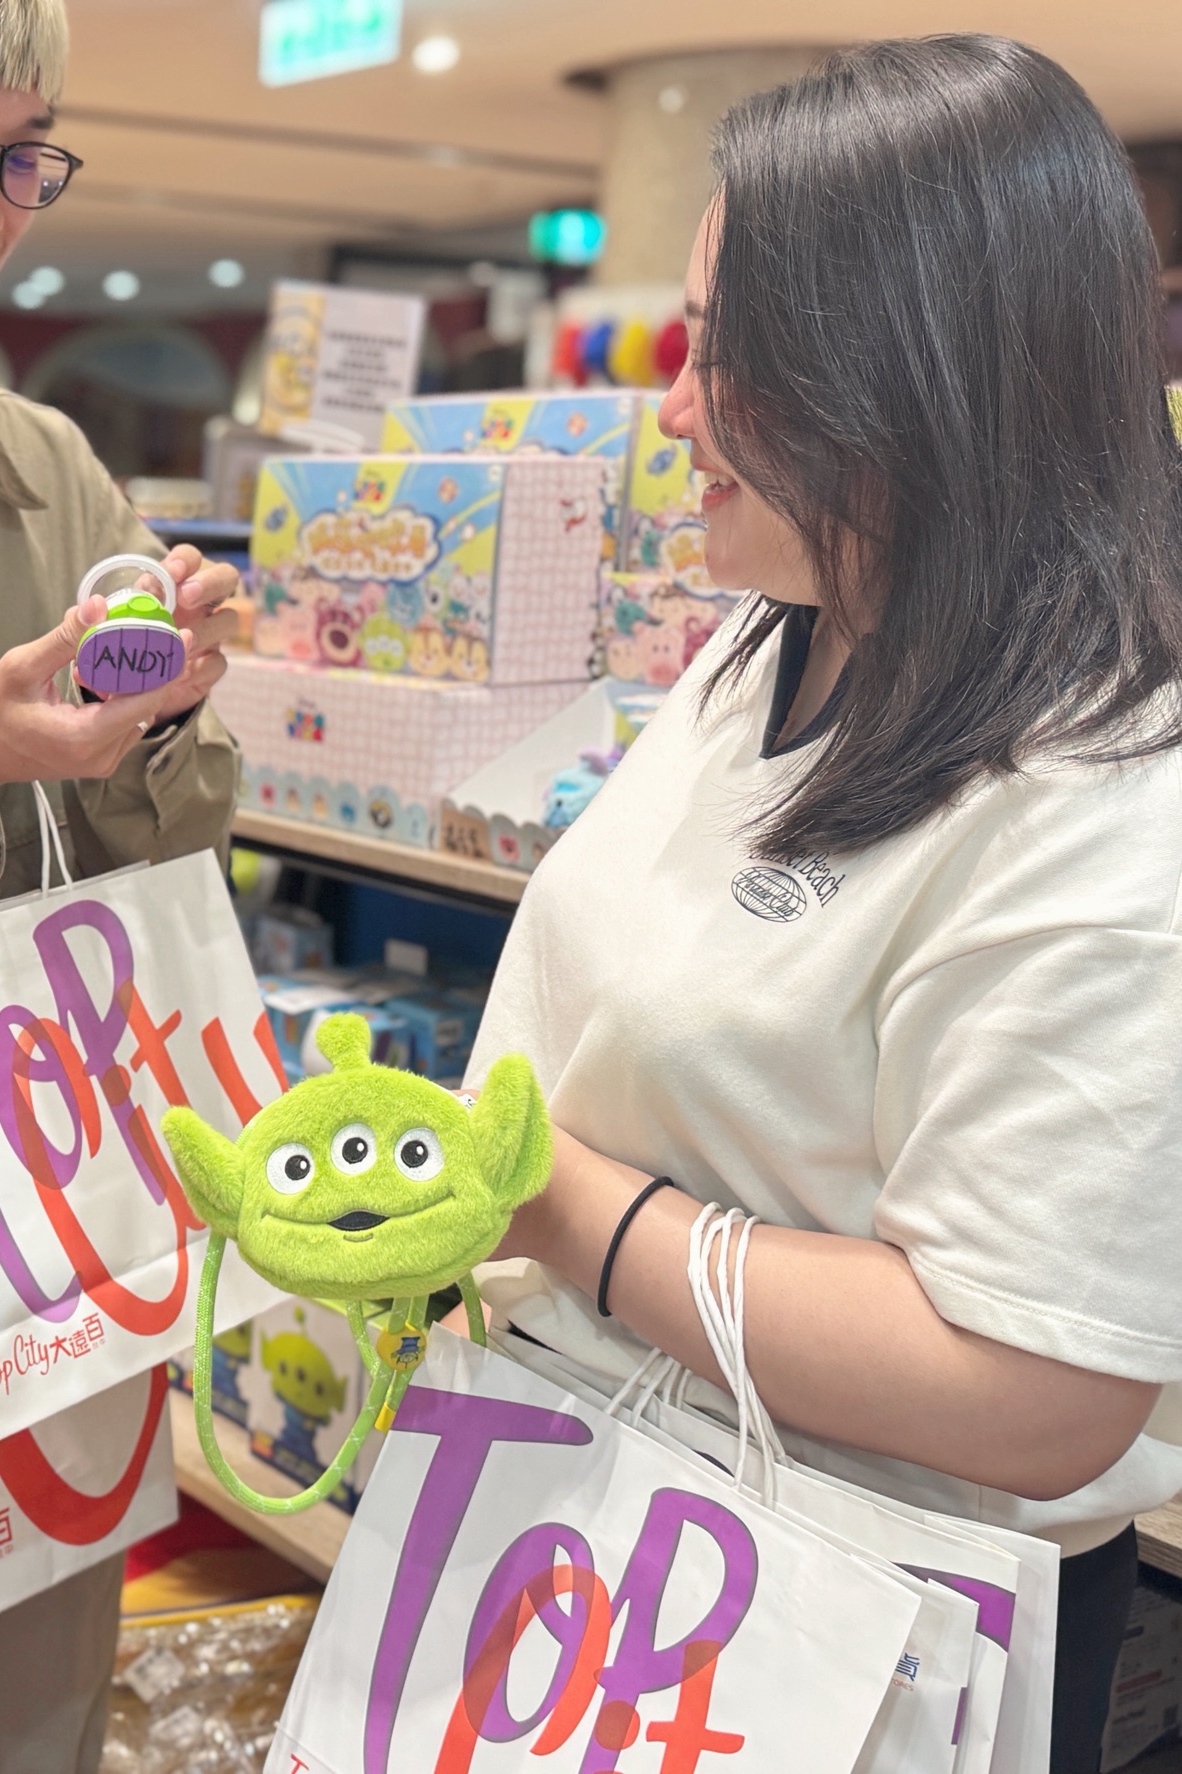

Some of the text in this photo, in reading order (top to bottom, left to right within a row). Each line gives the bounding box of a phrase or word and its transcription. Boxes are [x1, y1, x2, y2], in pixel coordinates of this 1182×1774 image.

[93, 645, 174, 678] ANDY
[13, 1333, 50, 1376] City
[49, 1312, 105, 1364] 大遠百
